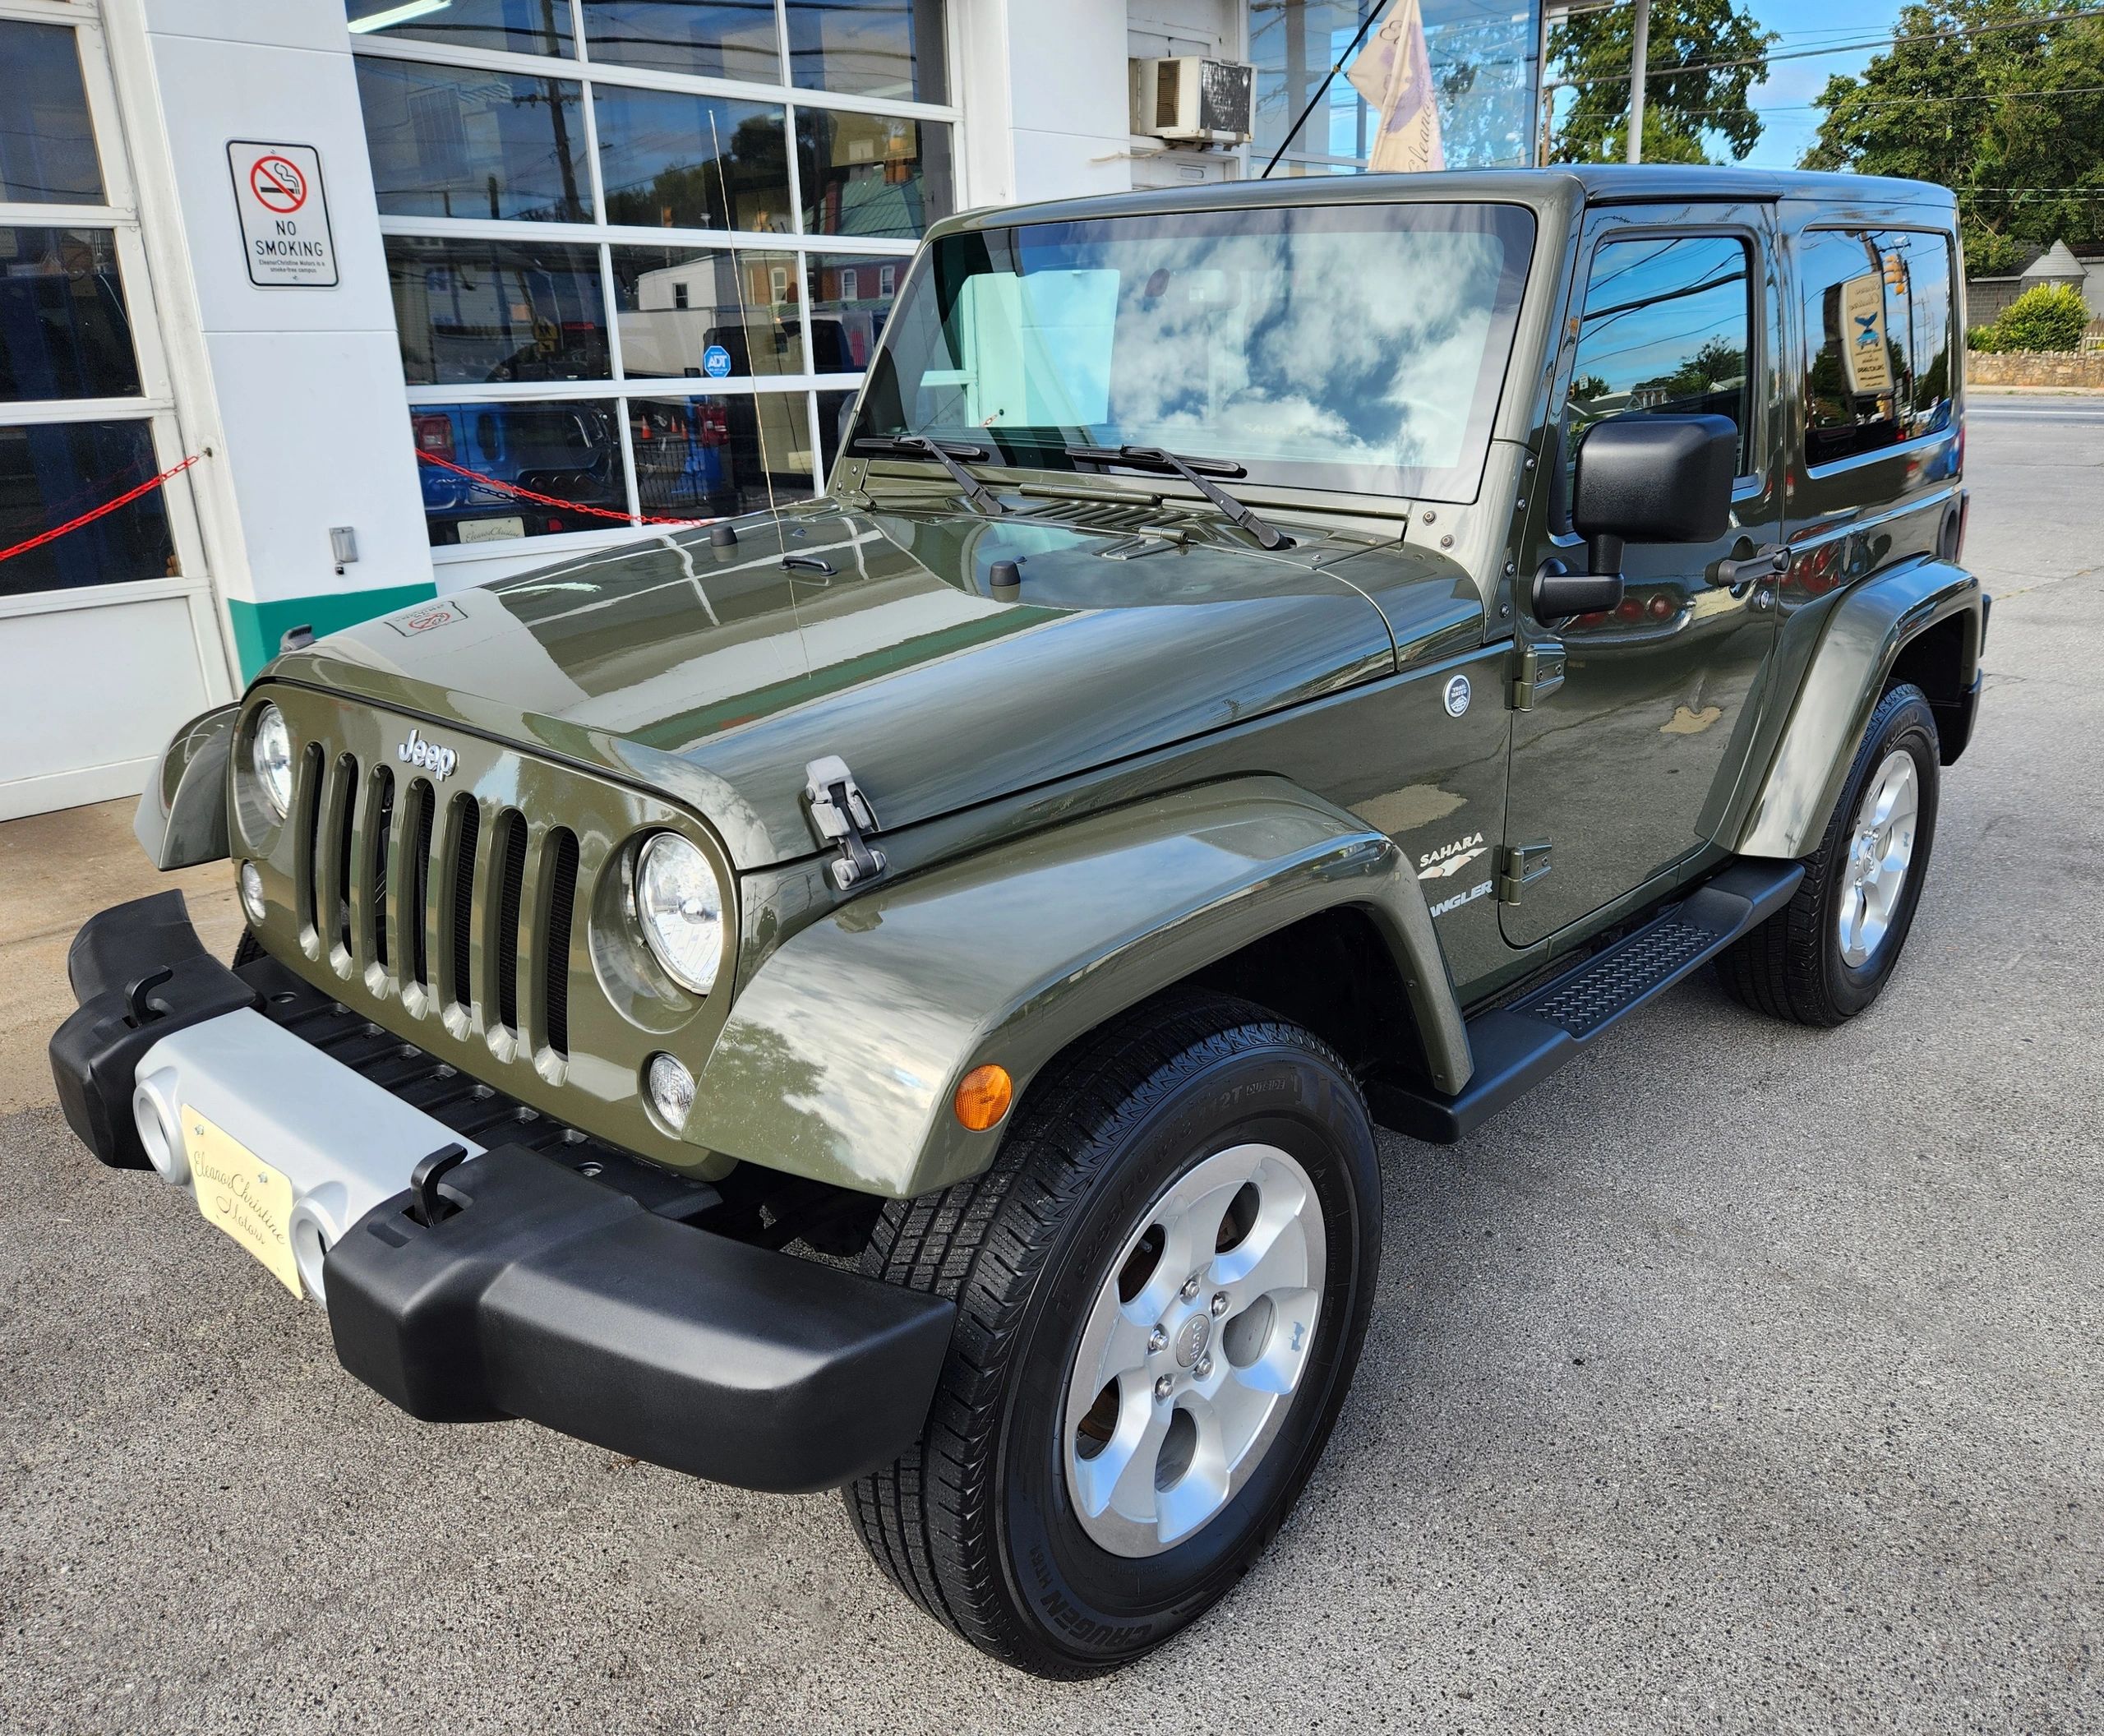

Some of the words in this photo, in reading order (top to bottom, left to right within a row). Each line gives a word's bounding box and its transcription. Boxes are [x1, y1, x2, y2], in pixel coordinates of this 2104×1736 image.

[275, 219, 297, 236] NO
[256, 240, 323, 256] SMOKING
[708, 354, 727, 368] ADT
[398, 728, 459, 782] Jeep
[1419, 832, 1484, 867] SAHARA
